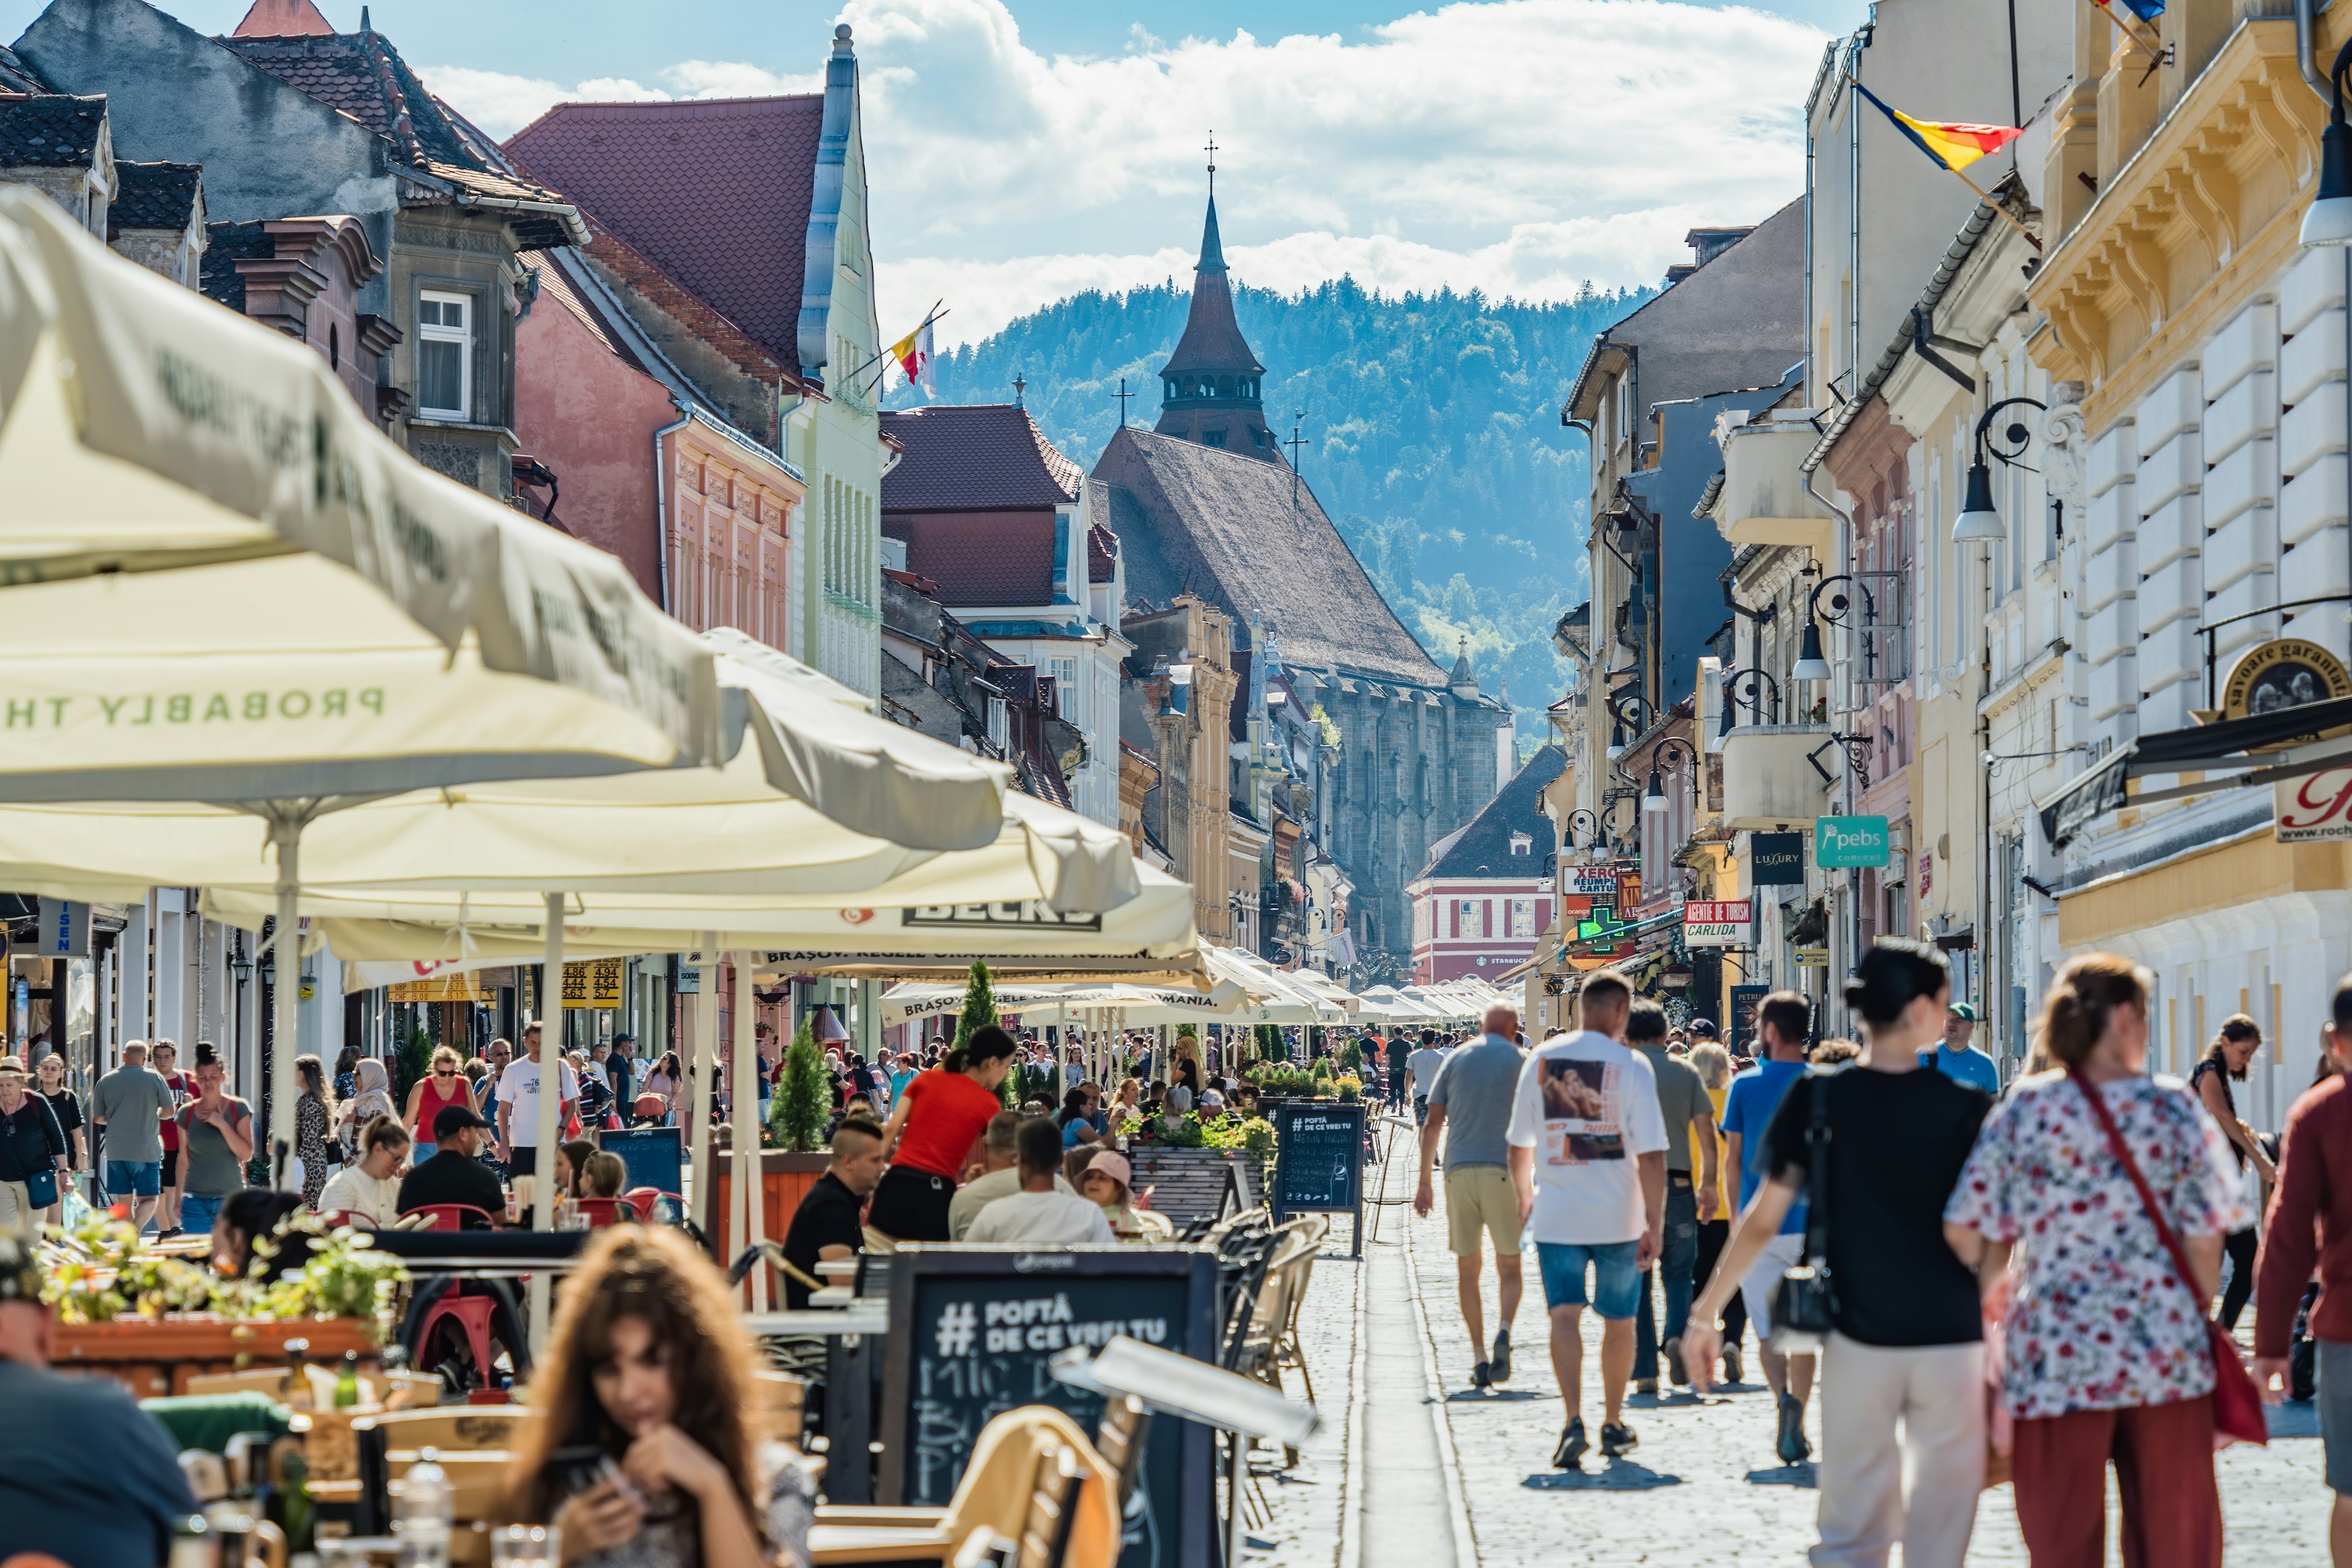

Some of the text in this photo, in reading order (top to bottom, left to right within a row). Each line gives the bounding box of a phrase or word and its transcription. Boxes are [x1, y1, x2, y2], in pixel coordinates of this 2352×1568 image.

[2231, 644, 2348, 706] savoare garantat
[1838, 829, 1880, 850] pebs
[1687, 903, 1749, 921] AGENTIE DE TURISM
[1687, 924, 1736, 936] CARLIDA
[564, 968, 617, 976] 4,86 4,94
[413, 982, 428, 991] 5.63
[562, 978, 616, 987] 4,44 4,54
[562, 989, 609, 998] 5,63 5,7
[984, 1292, 1074, 1327] POFTĂ
[986, 1327, 1024, 1353] DE
[1025, 1324, 1065, 1350] CE
[1128, 1317, 1167, 1344] TU
